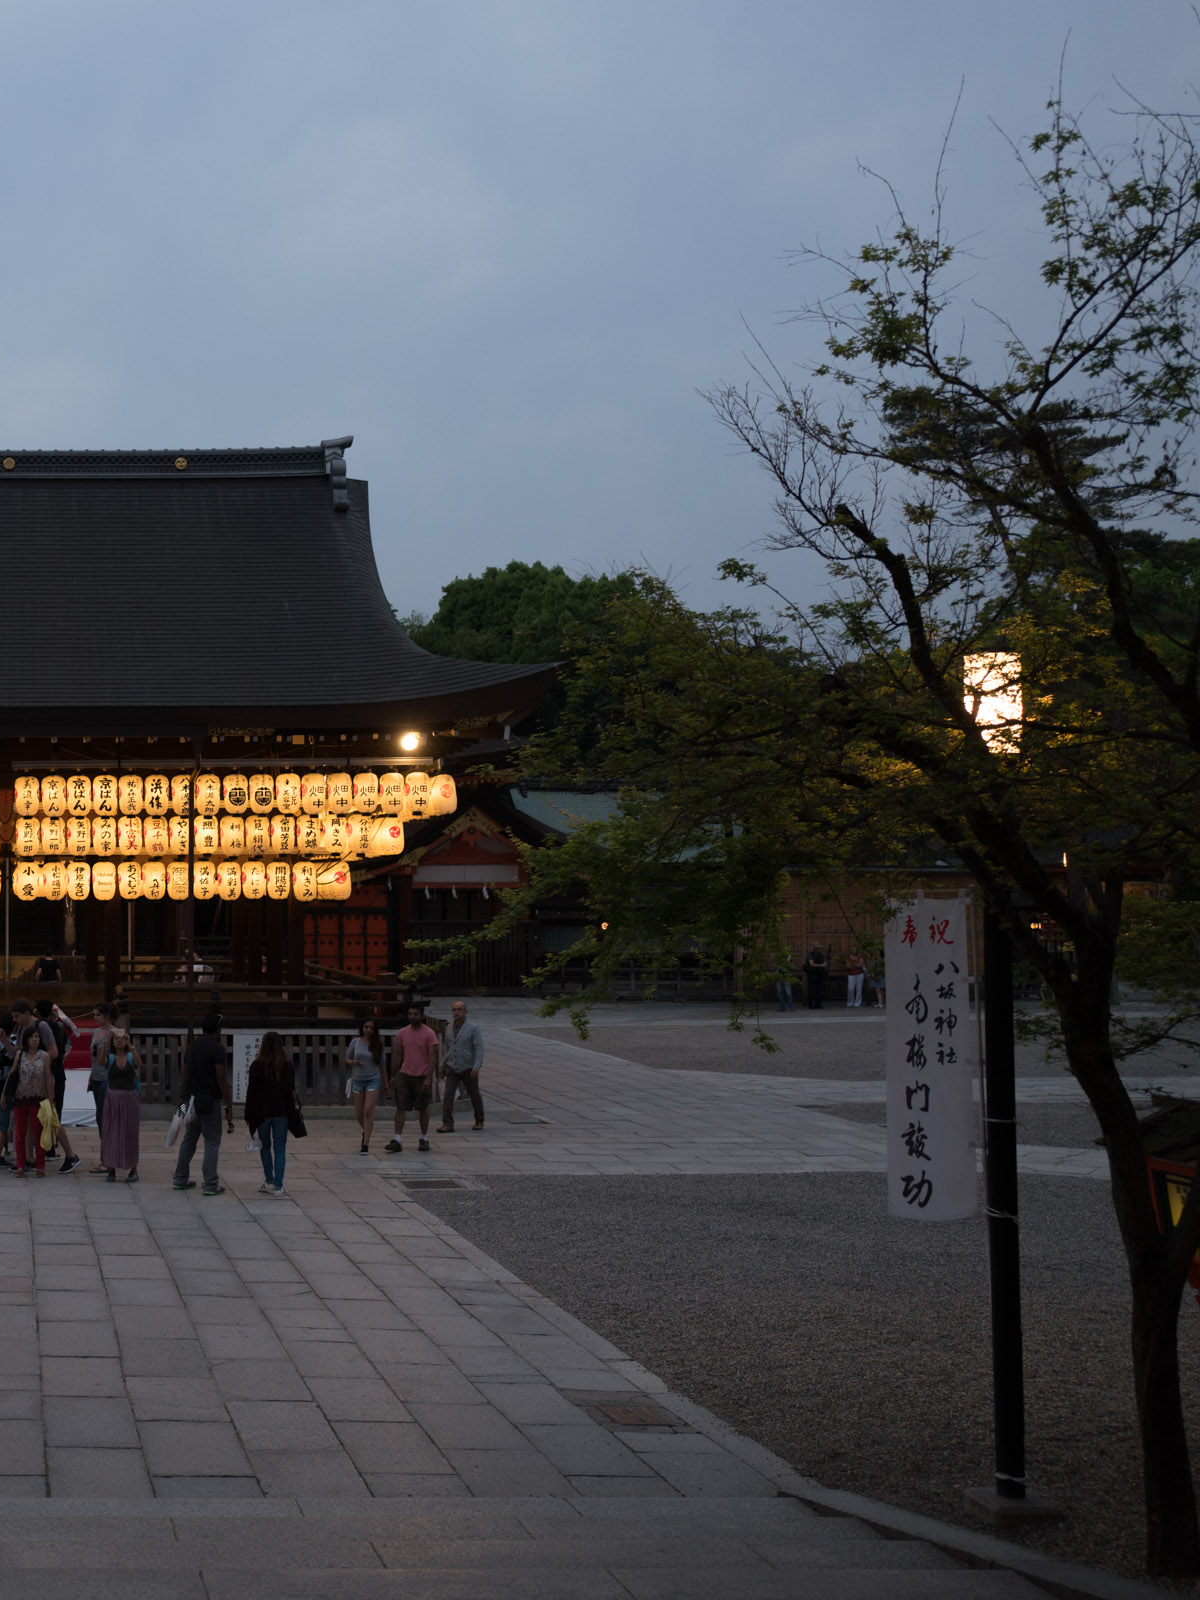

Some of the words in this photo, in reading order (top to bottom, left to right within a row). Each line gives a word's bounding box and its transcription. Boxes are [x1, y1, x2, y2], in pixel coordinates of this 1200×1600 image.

[47, 779, 60, 812] 京ばん
[72, 777, 86, 811] 京ばん
[99, 777, 112, 811] 京ばん
[309, 786, 324, 808] 畑中
[333, 784, 348, 807] 畑中
[359, 785, 376, 808] 畑中
[385, 785, 401, 806] 畑中
[411, 784, 428, 807] 畑中
[23, 822, 33, 852] 矢野一郎
[76, 821, 86, 852] 矢野一郎
[100, 819, 112, 852] みの家
[177, 819, 187, 851] やなぎ
[22, 866, 35, 897] 小愛
[127, 864, 137, 896] おくむら
[275, 866, 287, 897] 開陽亭
[934, 961, 960, 1066] 八坂神社
